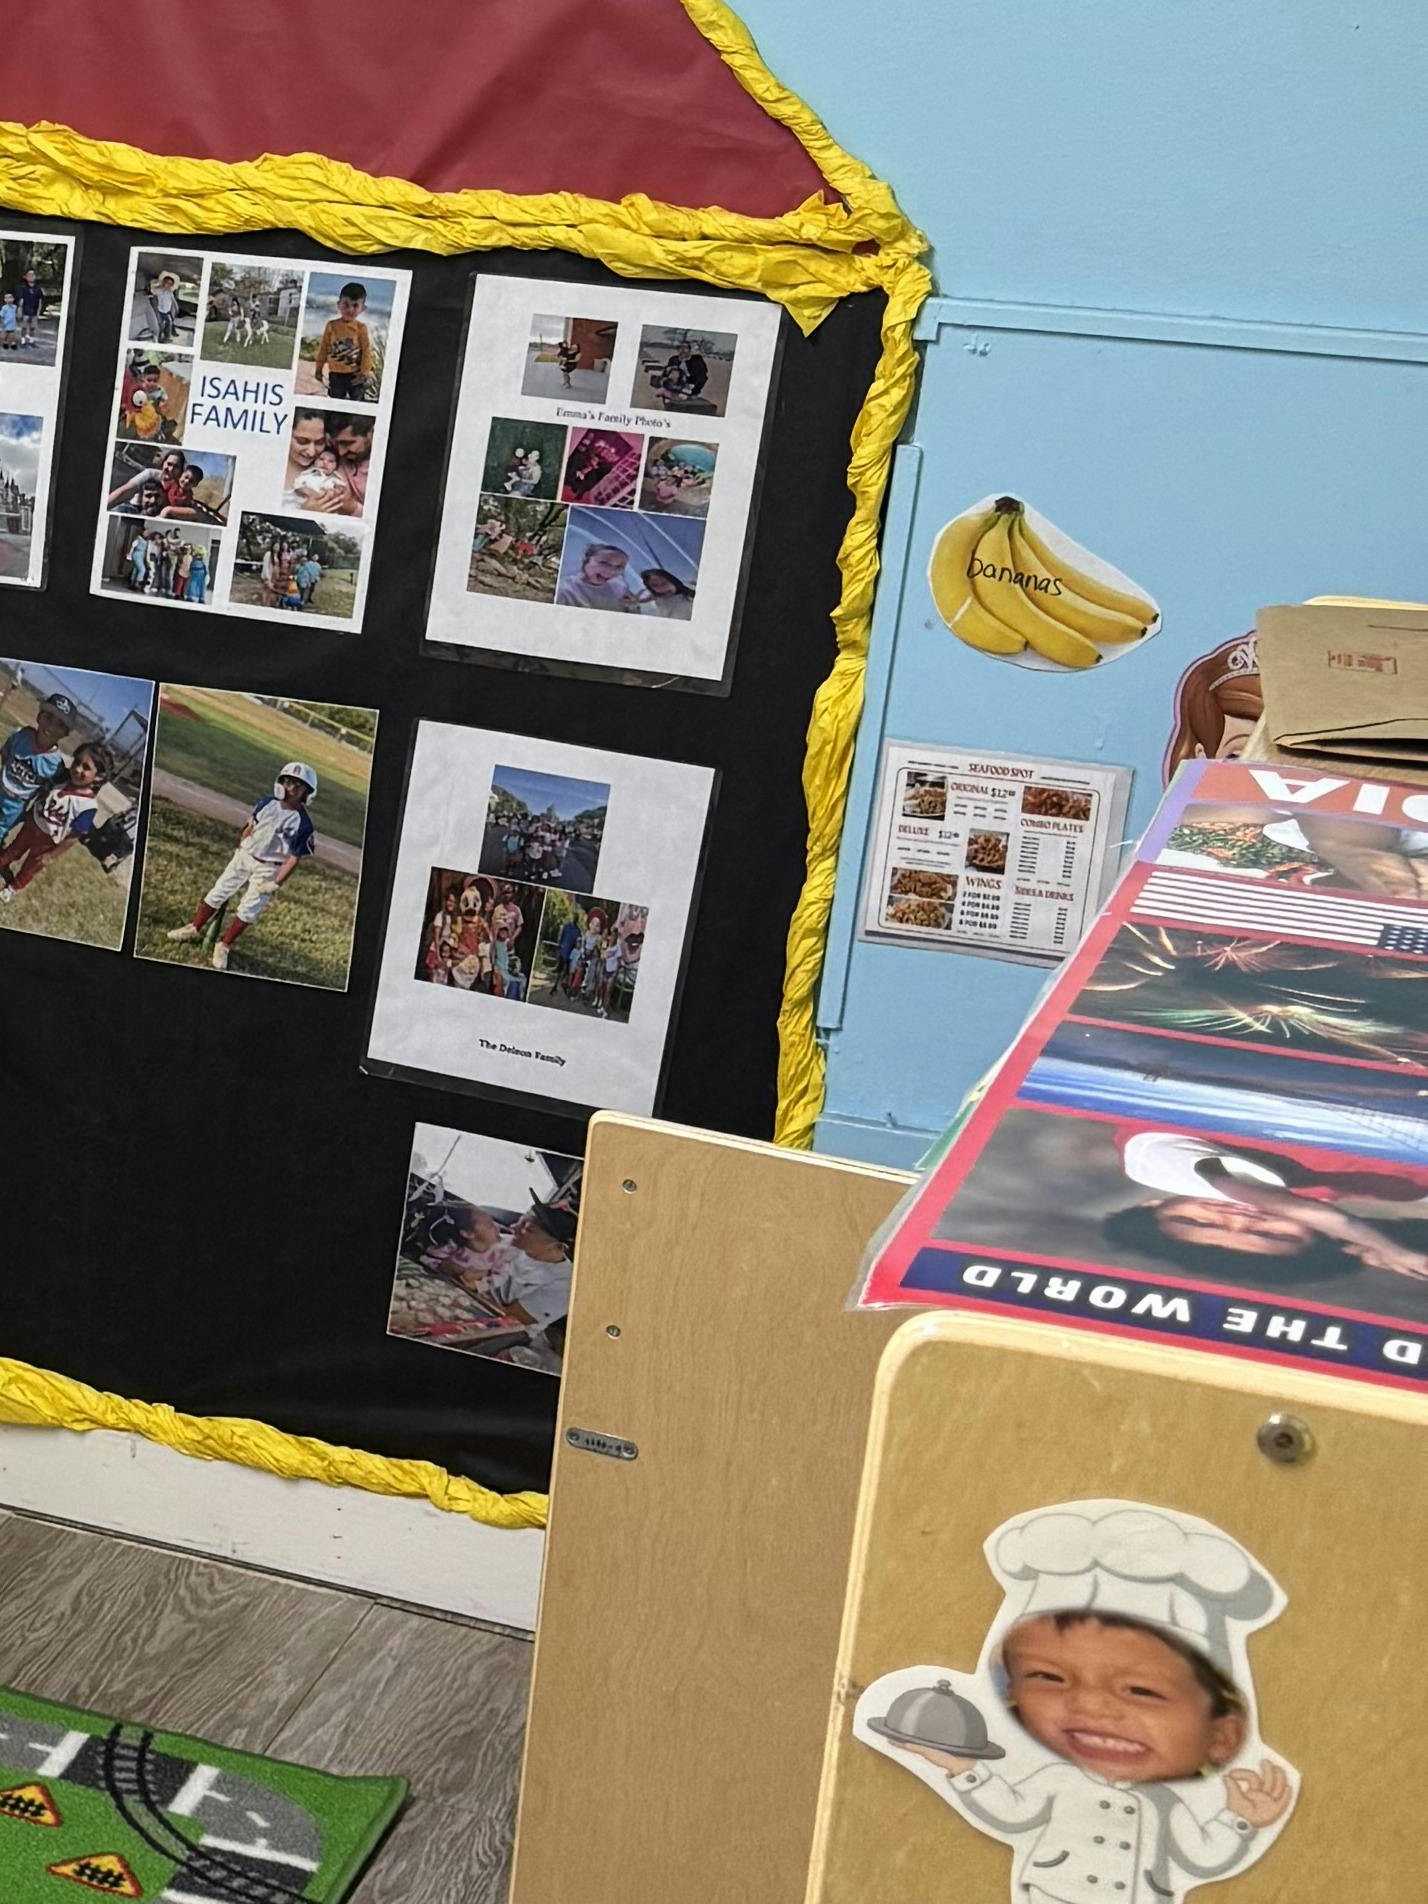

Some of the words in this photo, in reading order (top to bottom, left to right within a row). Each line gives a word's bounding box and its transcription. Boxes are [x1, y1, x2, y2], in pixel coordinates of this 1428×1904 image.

[200, 374, 285, 408] ISAHIS
[189, 403, 288, 436] FAMILY
[556, 407, 595, 420] Emma's
[598, 411, 632, 426] Family
[635, 416, 671, 428] Photo's
[966, 556, 1064, 597] bananas
[968, 763, 1010, 777] SEAFOOD
[1010, 767, 1035, 780] SPOT
[951, 782, 989, 795] ORIGINAL
[898, 825, 929, 836] DELUXE
[1020, 818, 1051, 831] COMBO
[1052, 822, 1085, 834] PLATES
[966, 876, 1002, 891] WINGS
[962, 1263, 1191, 1324] WORLD
[1222, 1307, 1349, 1352] THE
